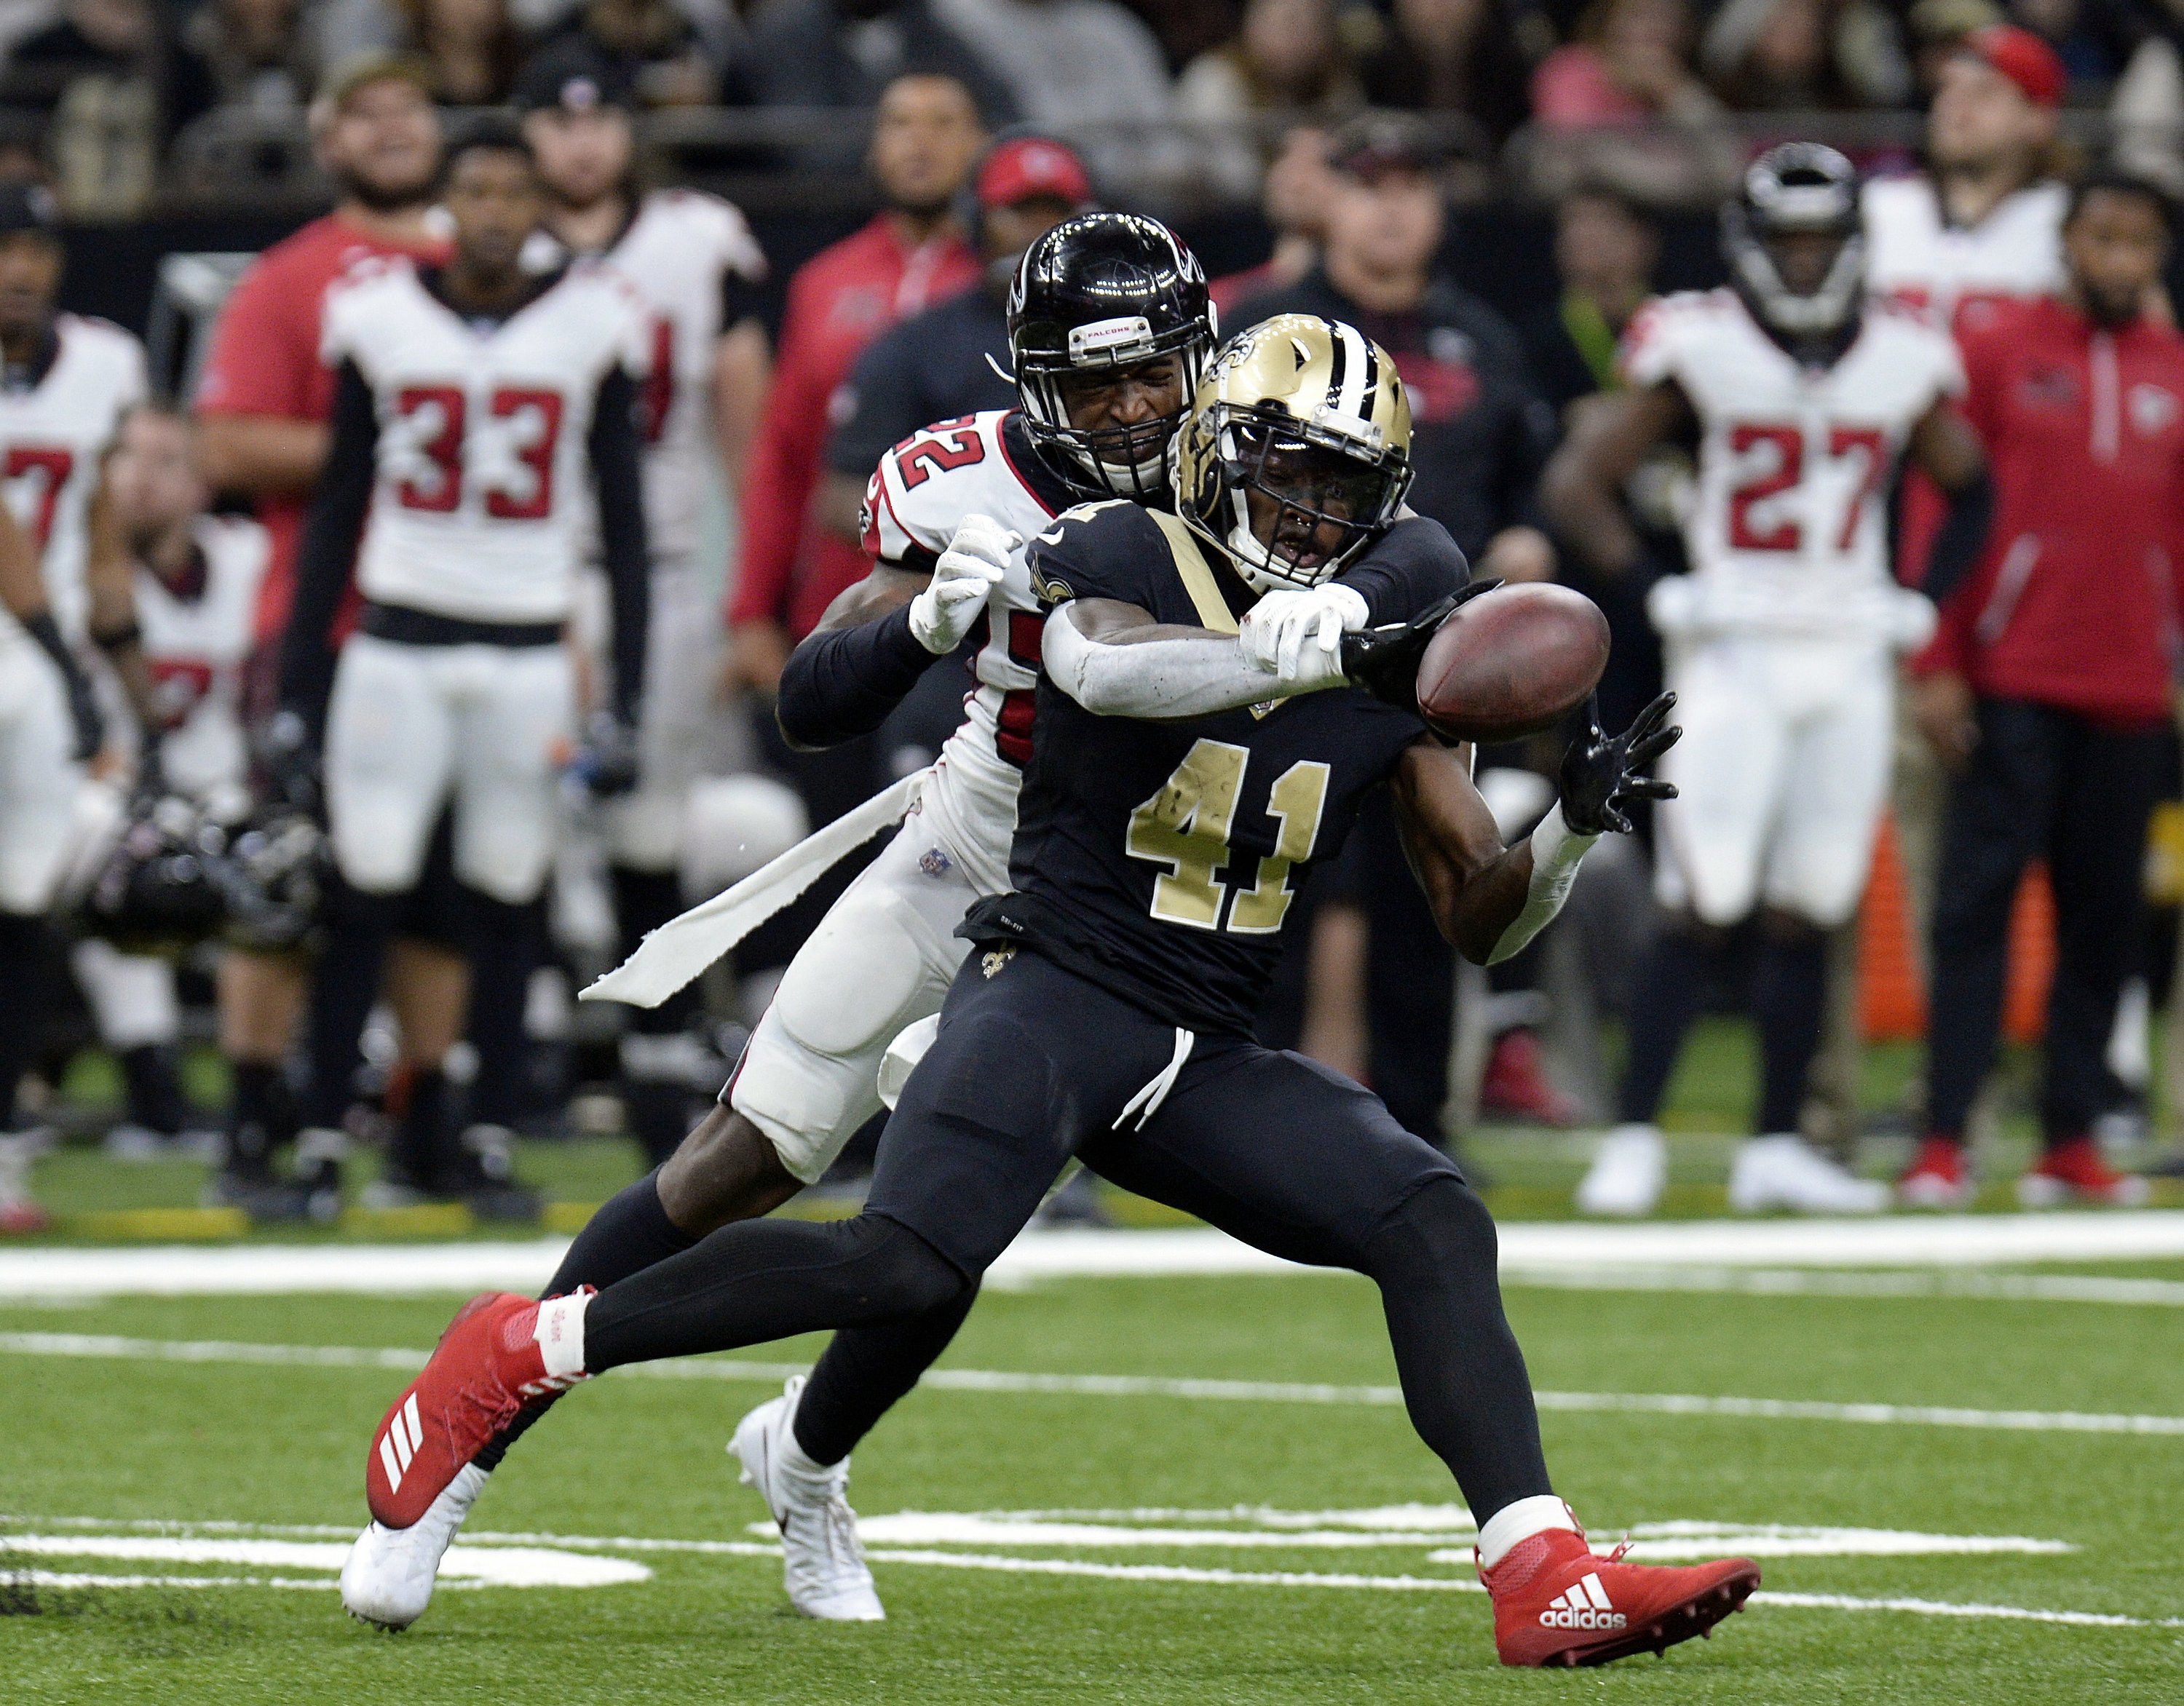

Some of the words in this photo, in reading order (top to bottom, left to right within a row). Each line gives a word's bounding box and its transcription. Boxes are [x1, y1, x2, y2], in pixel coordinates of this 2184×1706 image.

[1088, 326, 1130, 338] FALCONS
[397, 386, 565, 518] 33
[1728, 425, 1887, 552] 27
[1125, 737, 1332, 935] 41
[1539, 1606, 1627, 1630] adidas
